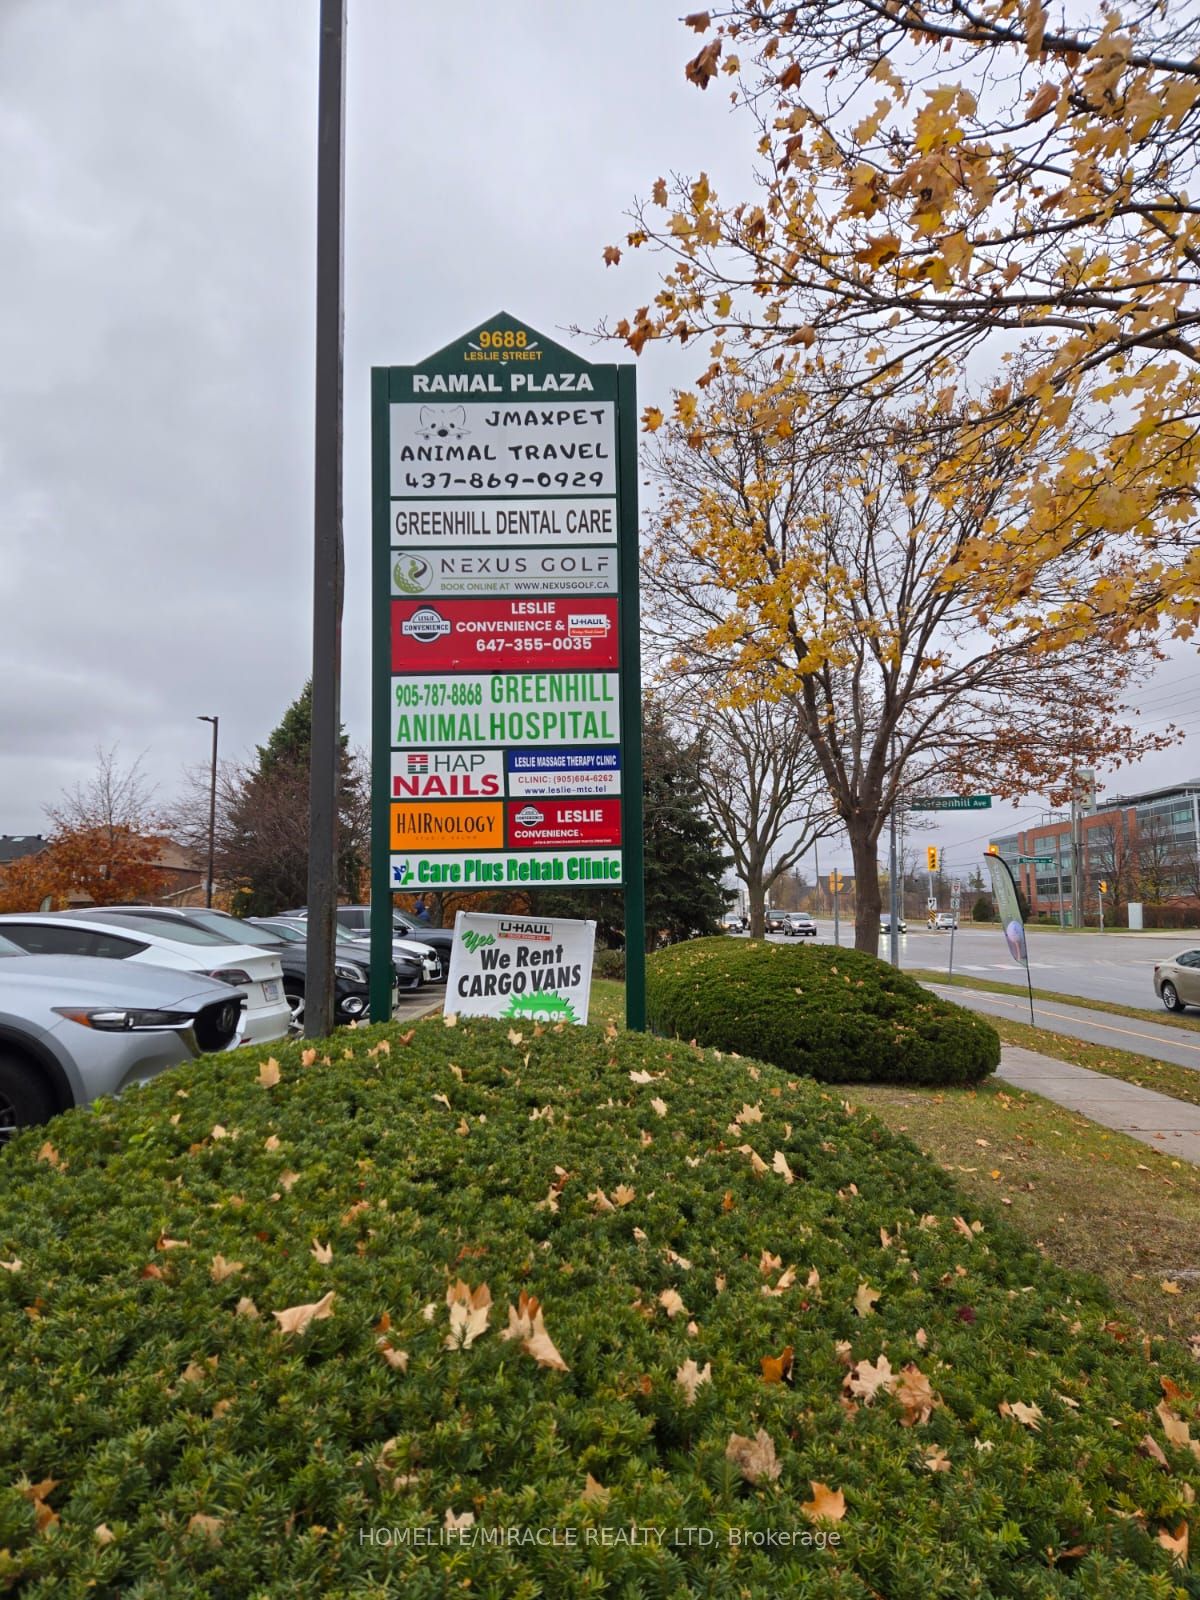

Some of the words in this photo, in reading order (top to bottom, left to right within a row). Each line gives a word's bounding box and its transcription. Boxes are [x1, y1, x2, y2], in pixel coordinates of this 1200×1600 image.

[480, 331, 527, 348] 9688
[464, 352, 500, 360] LESLIE
[502, 351, 542, 360] STREET
[413, 374, 502, 392] RAMAL
[510, 373, 594, 392] PLAZA
[485, 409, 605, 426] JMAXPET
[400, 445, 496, 462] ANIMAL
[508, 443, 608, 460] TRAVEL
[405, 472, 604, 488] 437-869-0929
[396, 511, 490, 536] GREENHILL
[496, 510, 561, 534] DENTAL
[566, 509, 612, 533] CARE
[441, 557, 527, 573] NEXUS
[541, 556, 608, 572] GOLF
[466, 582, 497, 590] ONLINE
[514, 582, 609, 590] WWW.NEXUSGOLF.CA
[512, 602, 556, 614] LESLIE
[456, 620, 552, 632] CONVENIENCE
[555, 620, 565, 631] &
[476, 638, 592, 652] 647-355-0035
[396, 683, 482, 706] 905-787-8868
[490, 674, 614, 704] GREENHILL
[397, 713, 486, 742] ANIMAL
[490, 710, 614, 740] HOSPITAL
[435, 754, 485, 772] HAP
[514, 757, 536, 768] LESLIE
[537, 756, 566, 767] MASSAGE
[567, 756, 594, 766] THERAPY
[596, 754, 616, 766] CLINIC
[394, 774, 500, 796] NAILS
[518, 776, 552, 784] CLINIC:
[525, 786, 607, 794] www.leslie-mtc.tel
[924, 798, 970, 808] Greenhill
[557, 810, 603, 822] LESLIE
[418, 860, 460, 883] Care
[464, 858, 504, 882] Plus
[507, 858, 564, 882] Rehab
[567, 856, 620, 880] Clinic
[501, 922, 550, 934] U-HAUL
[462, 930, 496, 953] Yes
[481, 949, 510, 970] We
[516, 945, 564, 968] Rent
[458, 971, 526, 998] CARGO
[531, 964, 581, 992] VANS
